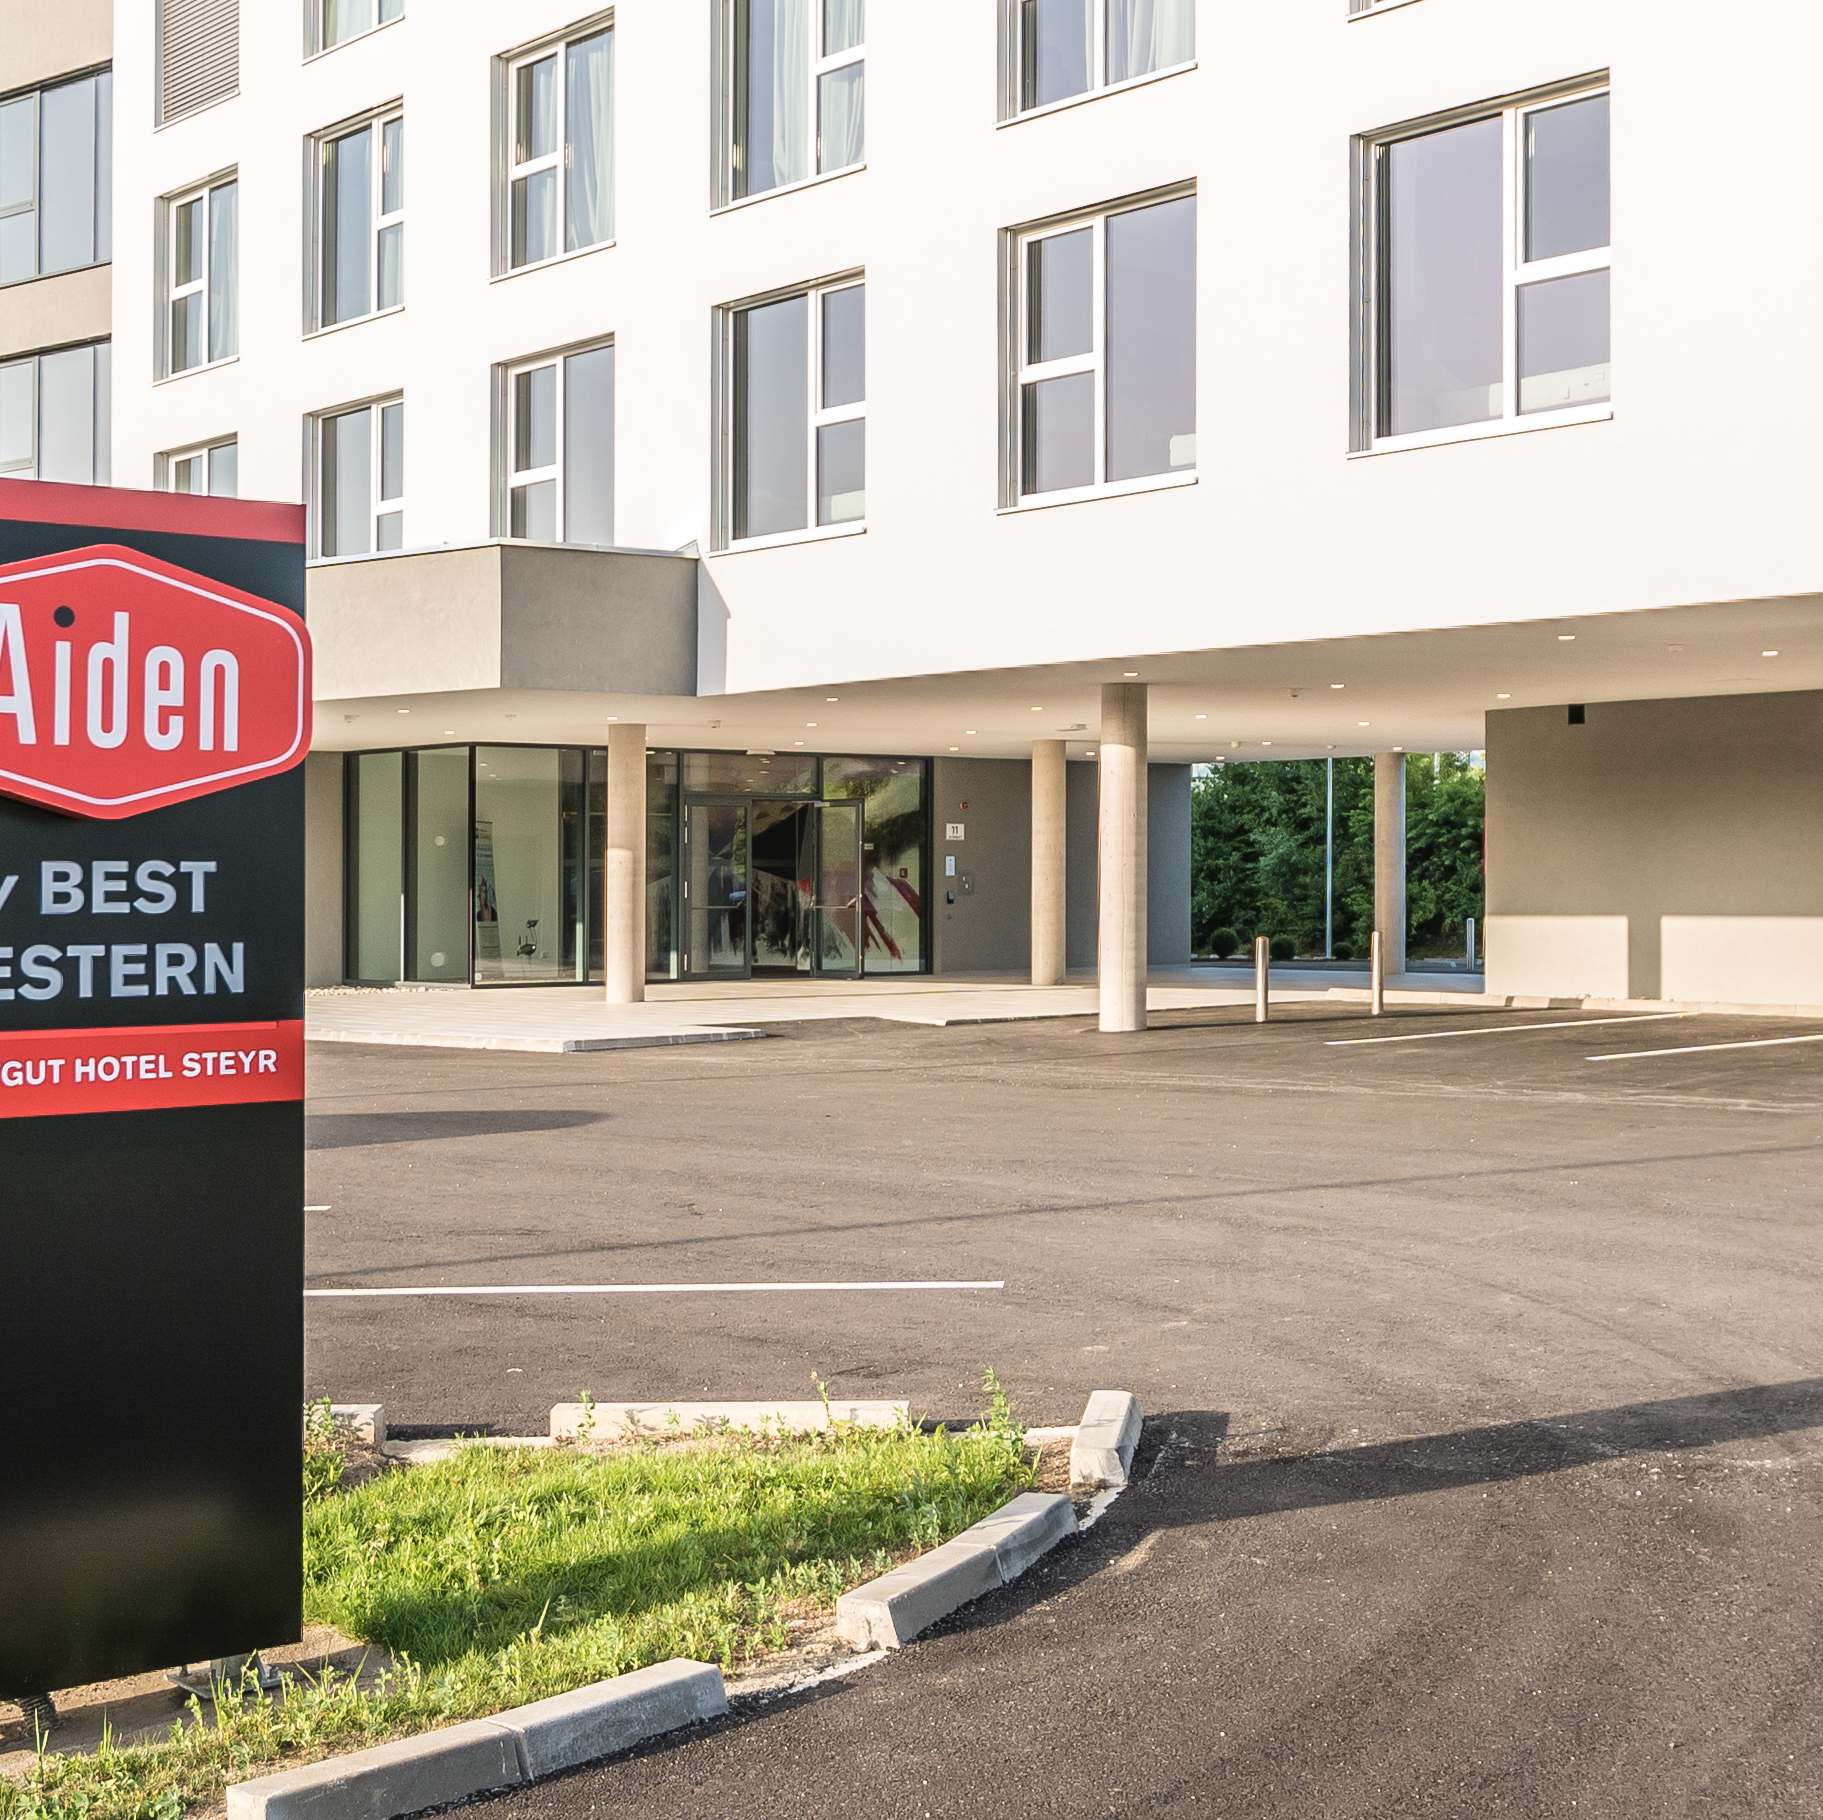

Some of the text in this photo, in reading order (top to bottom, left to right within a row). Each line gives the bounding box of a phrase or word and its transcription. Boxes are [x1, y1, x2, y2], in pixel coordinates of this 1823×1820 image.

[951, 825, 959, 834] 11
[40, 859, 217, 915] BEST
[75, 1054, 174, 1083] HOTEL
[182, 1049, 279, 1078] STEYR
